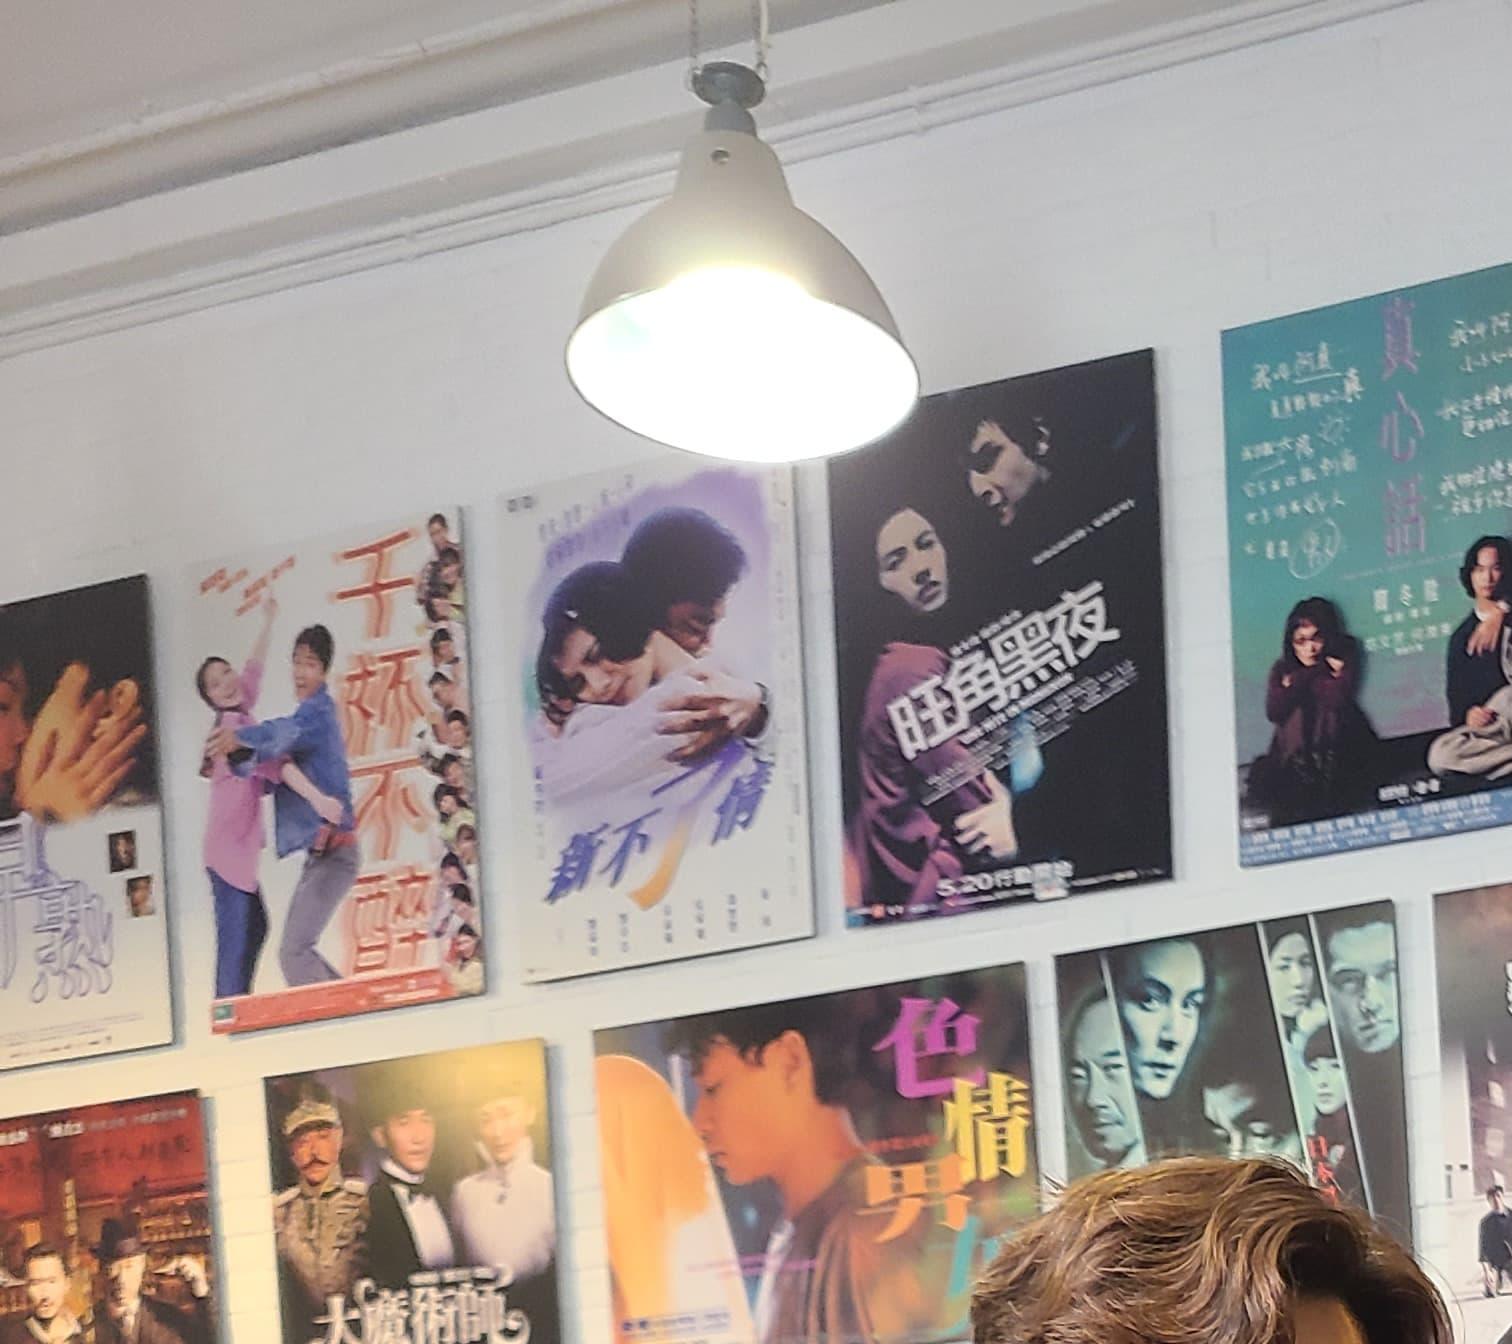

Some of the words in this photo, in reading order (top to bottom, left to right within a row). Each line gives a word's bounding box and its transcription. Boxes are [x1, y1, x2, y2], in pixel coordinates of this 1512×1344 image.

[1380, 296, 1426, 557] 真心話
[328, 528, 432, 978] 千杯不醉
[887, 579, 1121, 761] 旺角黑夜
